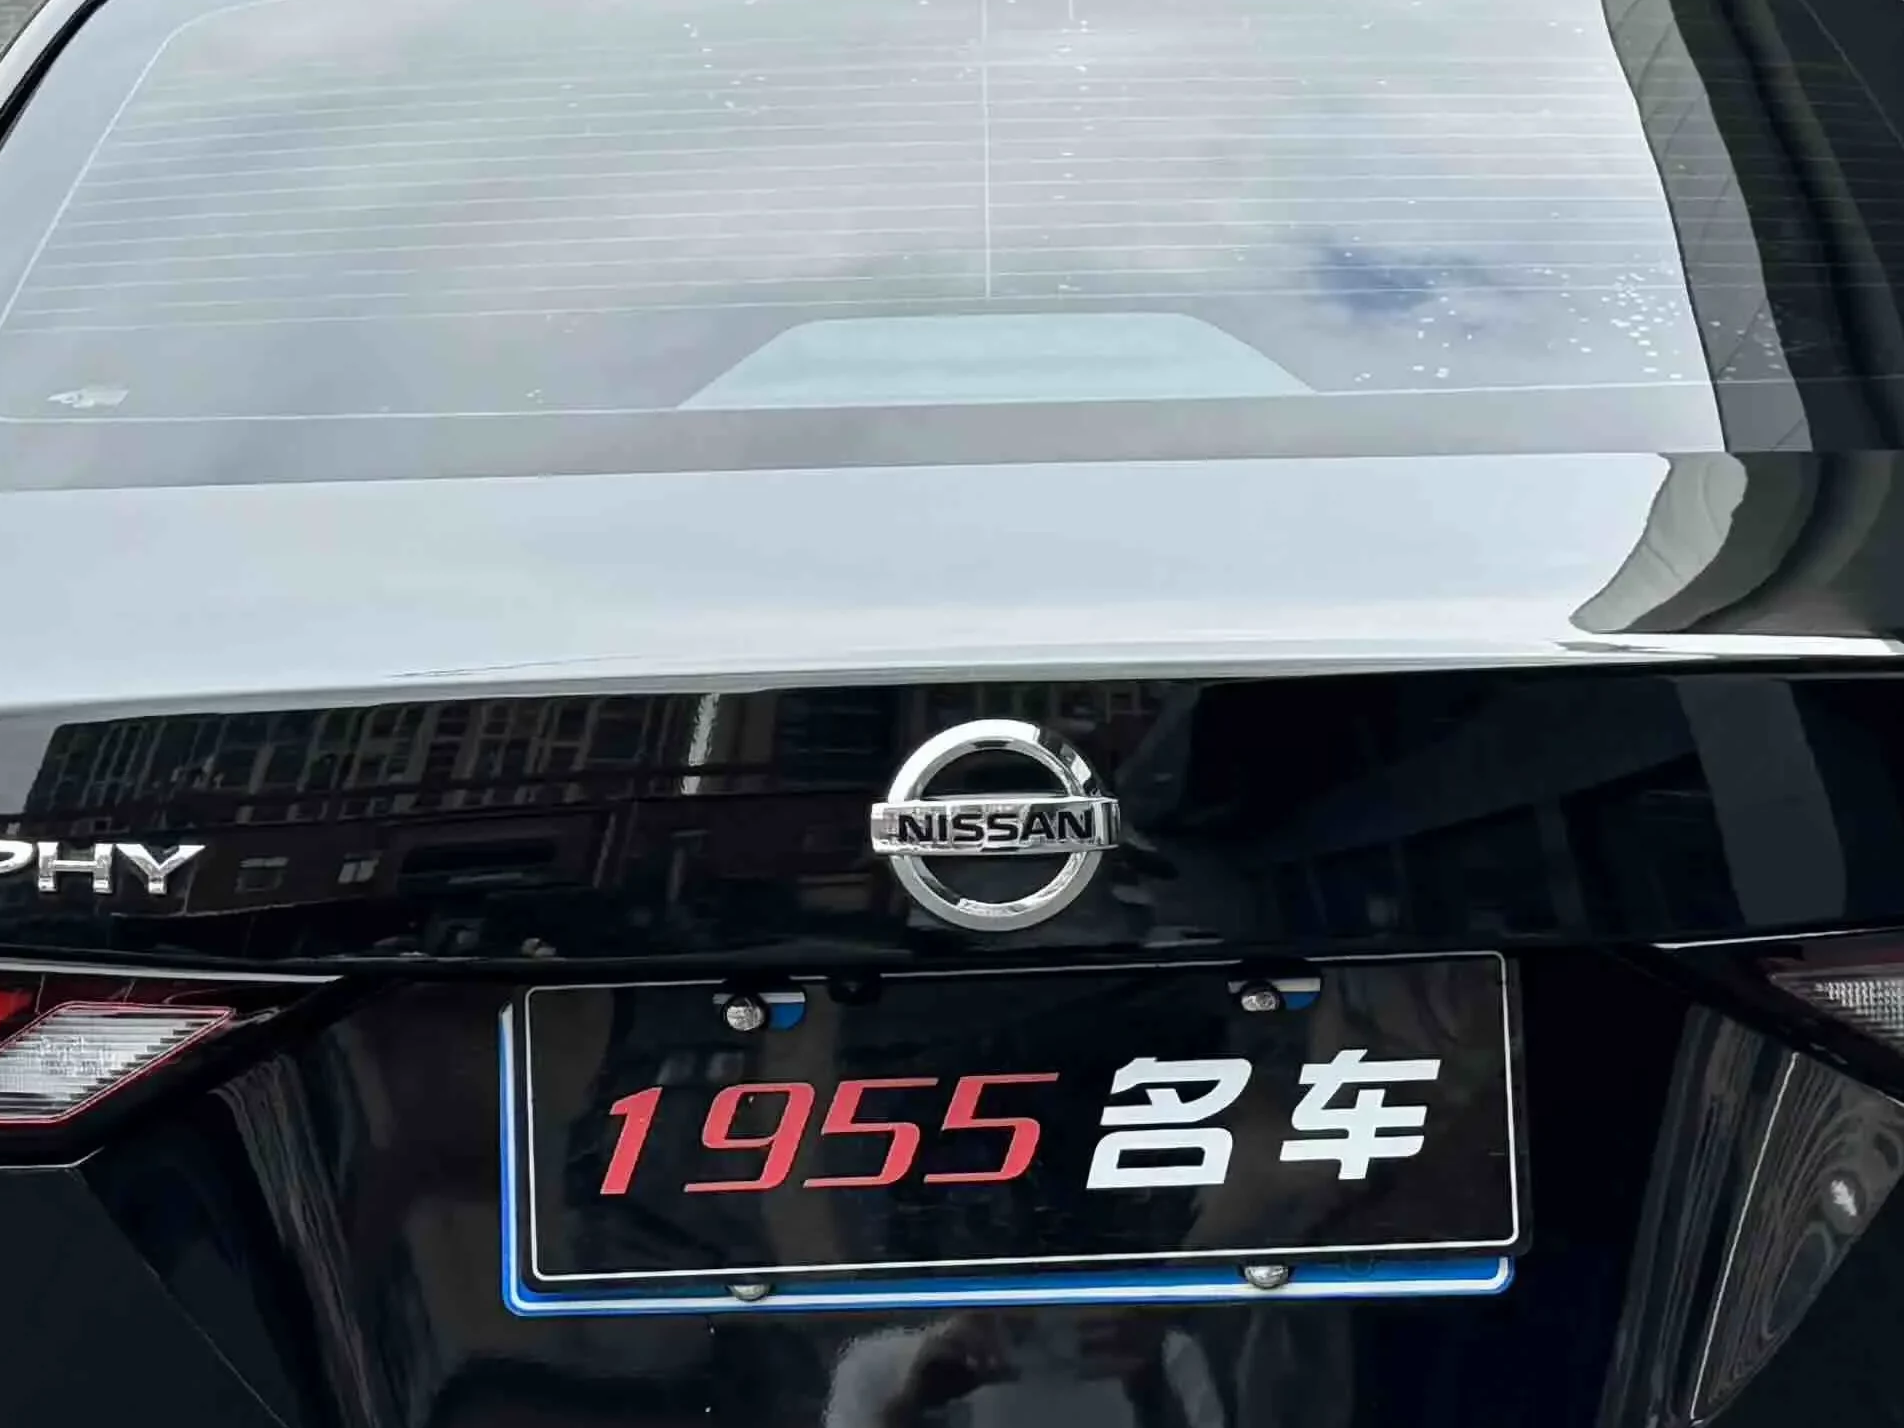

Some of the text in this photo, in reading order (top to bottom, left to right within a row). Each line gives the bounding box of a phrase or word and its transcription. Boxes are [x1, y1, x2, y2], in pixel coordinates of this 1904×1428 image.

[898, 810, 1094, 842] NISSAN
[599, 1049, 1441, 1195] 1955 名车
